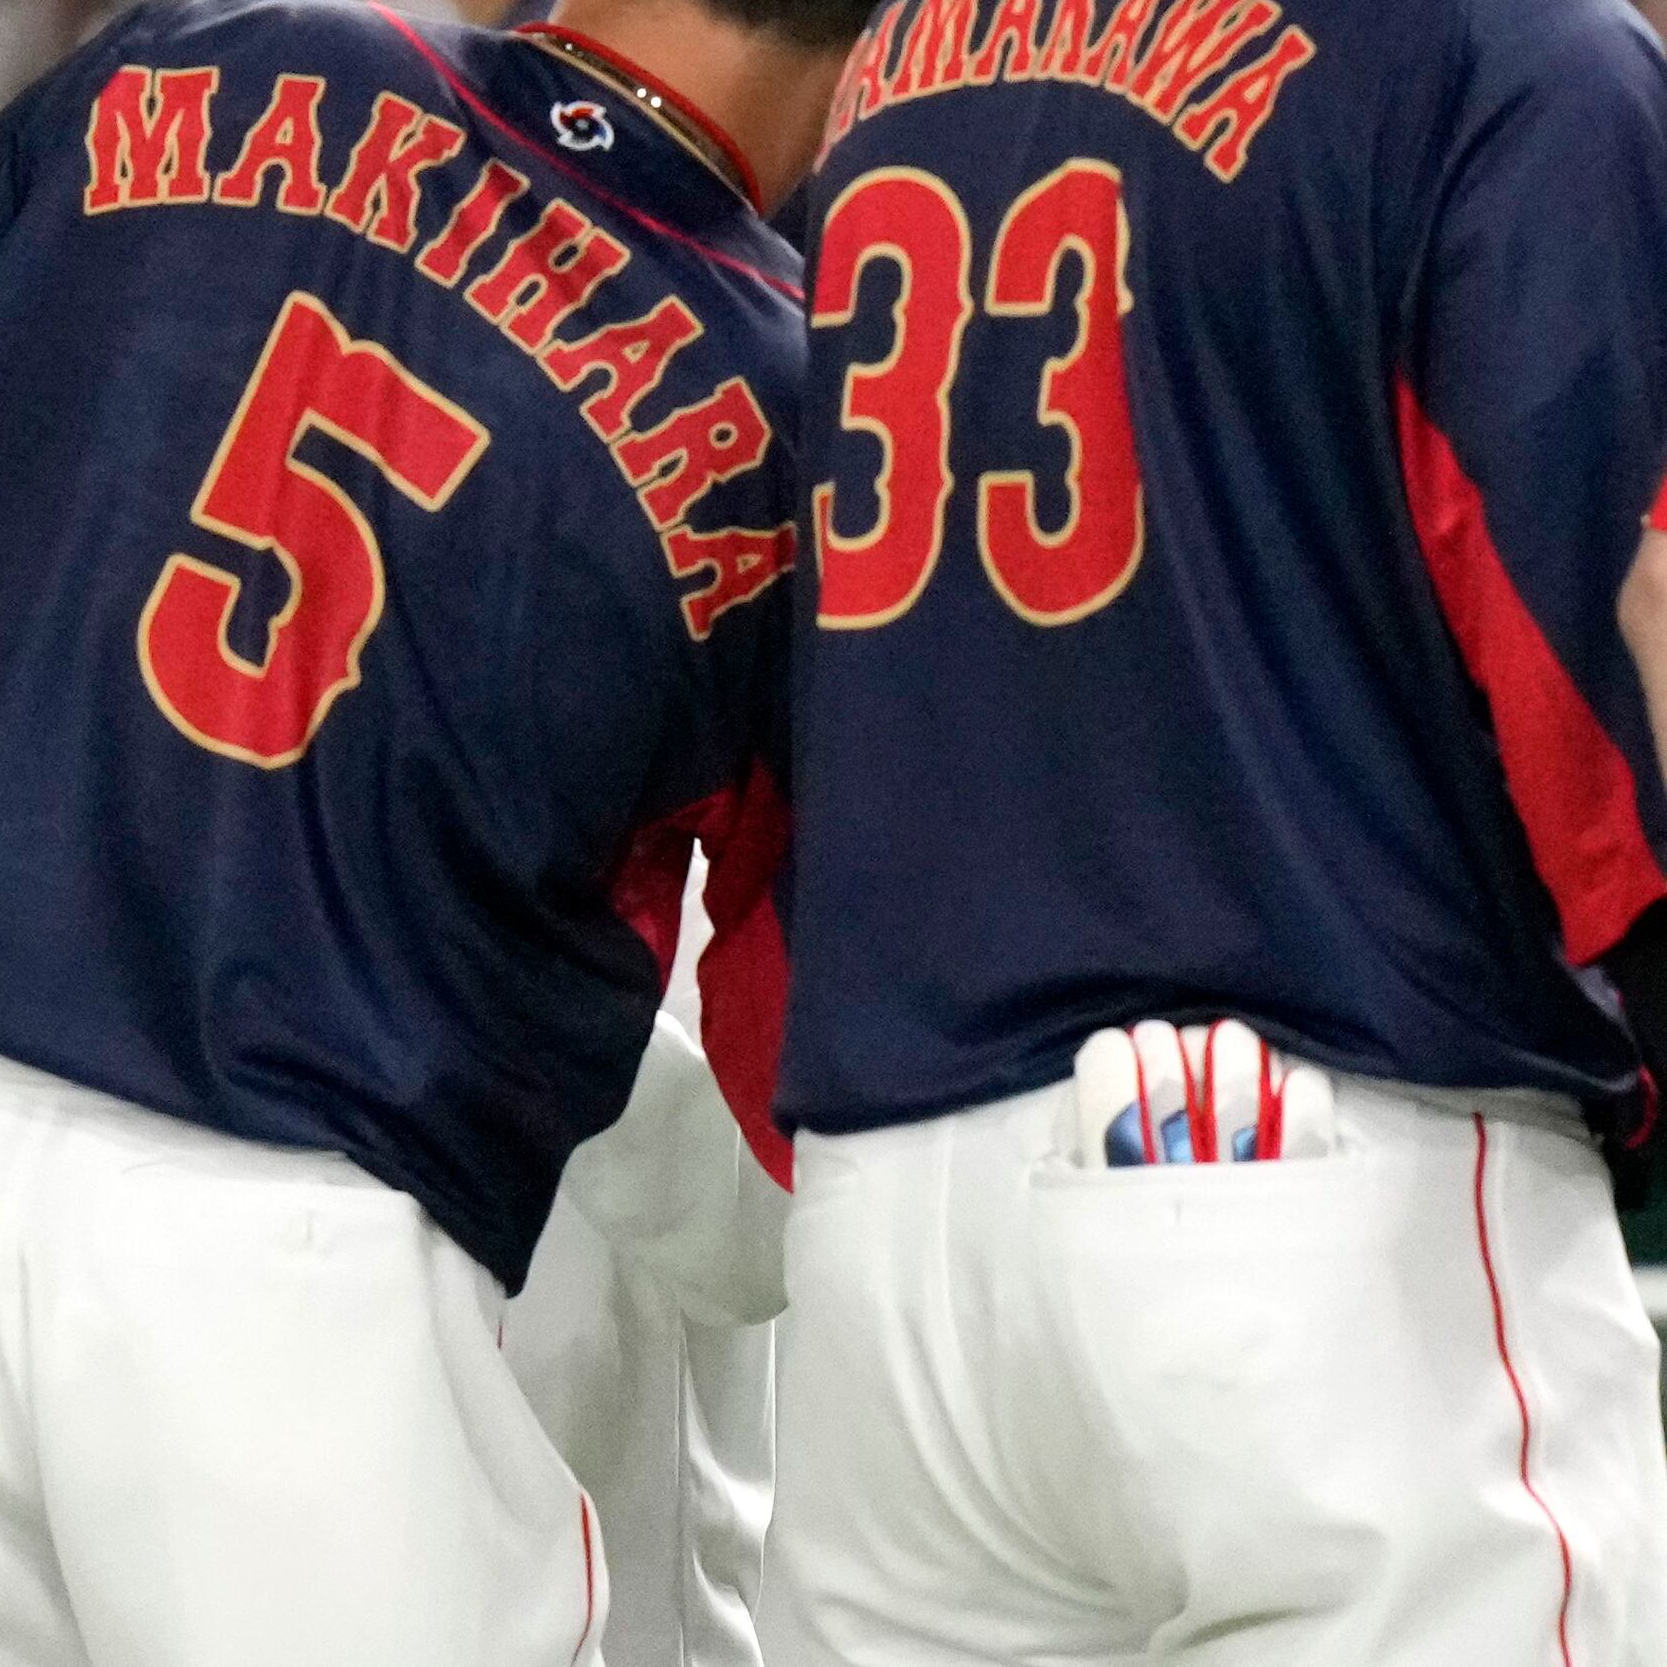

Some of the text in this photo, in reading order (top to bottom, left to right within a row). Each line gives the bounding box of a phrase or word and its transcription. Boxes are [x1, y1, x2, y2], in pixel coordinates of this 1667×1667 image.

[82, 64, 800, 642] MAKIHARA
[135, 290, 492, 770] 5
[810, 156, 1146, 631] 33
